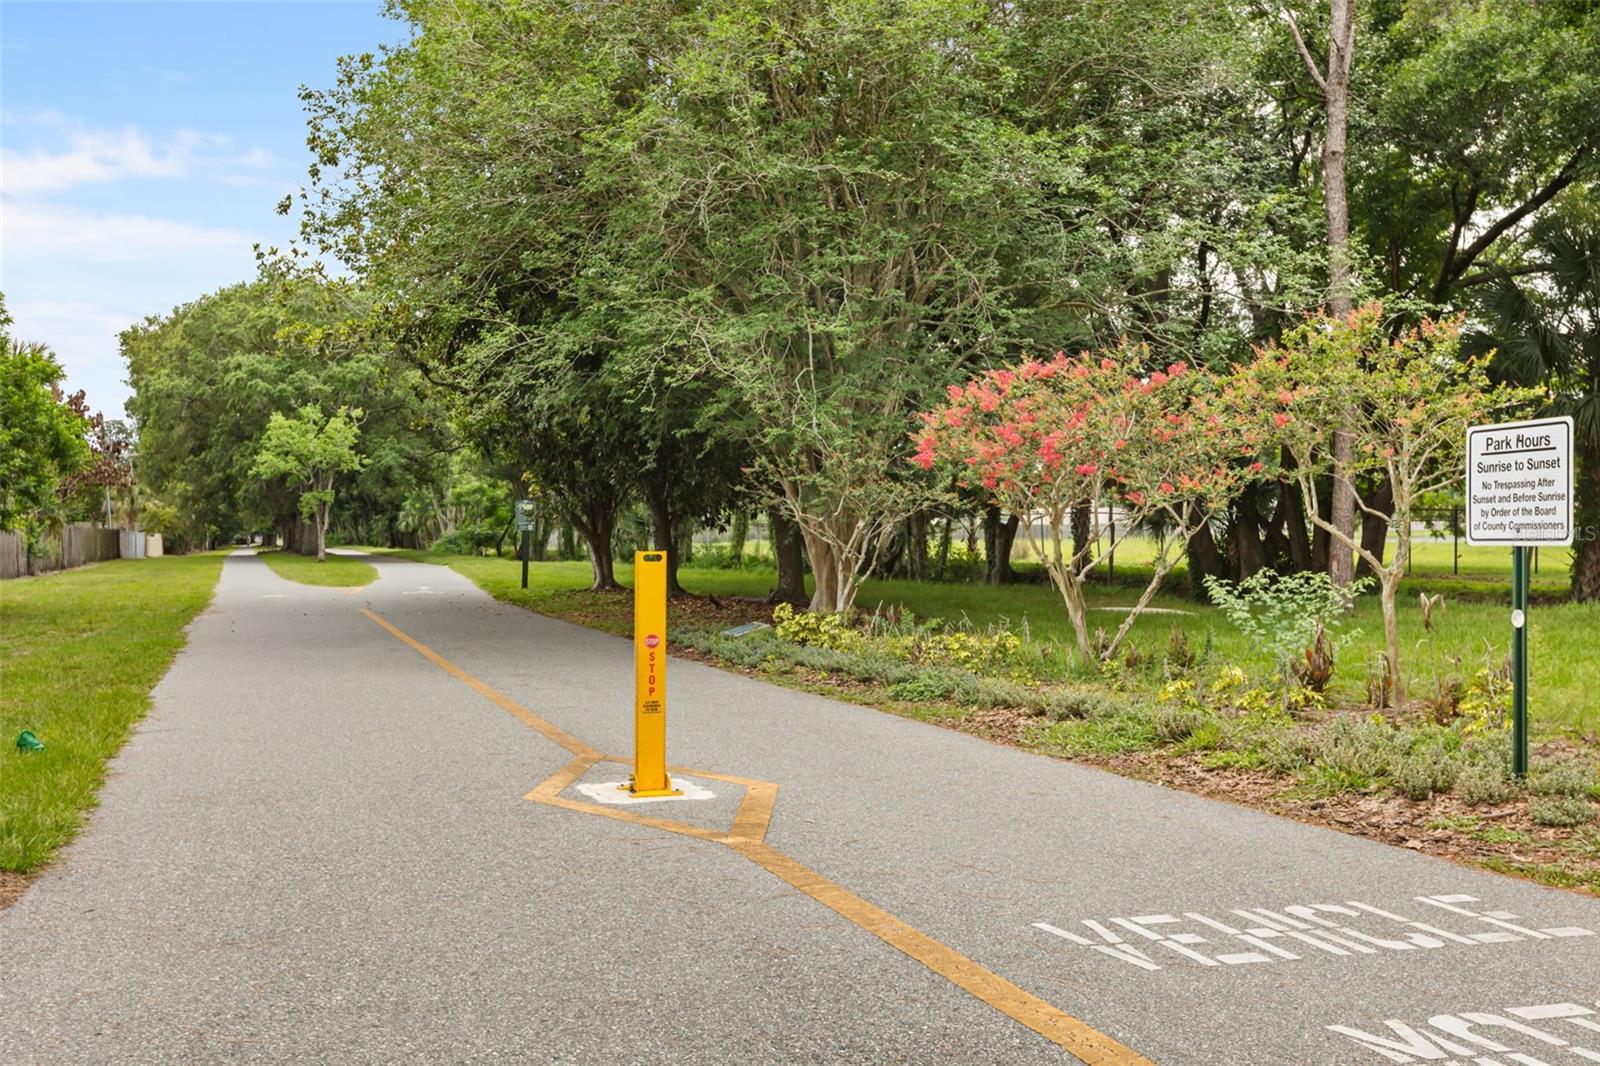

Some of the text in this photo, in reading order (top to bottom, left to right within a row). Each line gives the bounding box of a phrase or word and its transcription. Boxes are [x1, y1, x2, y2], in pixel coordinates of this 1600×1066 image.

[1486, 434, 1551, 451] Park Hours
[1477, 457, 1561, 474] Sunrise to Sunset
[1482, 478, 1555, 491] No Trespassing After
[1473, 492, 1566, 504] Sunset and Before Sunrise
[1481, 506, 1557, 519] by Order of the Board
[1473, 520, 1565, 532] of County Commissioners
[648, 652, 656, 696] STOP
[1031, 893, 1599, 970] VEHICLE
